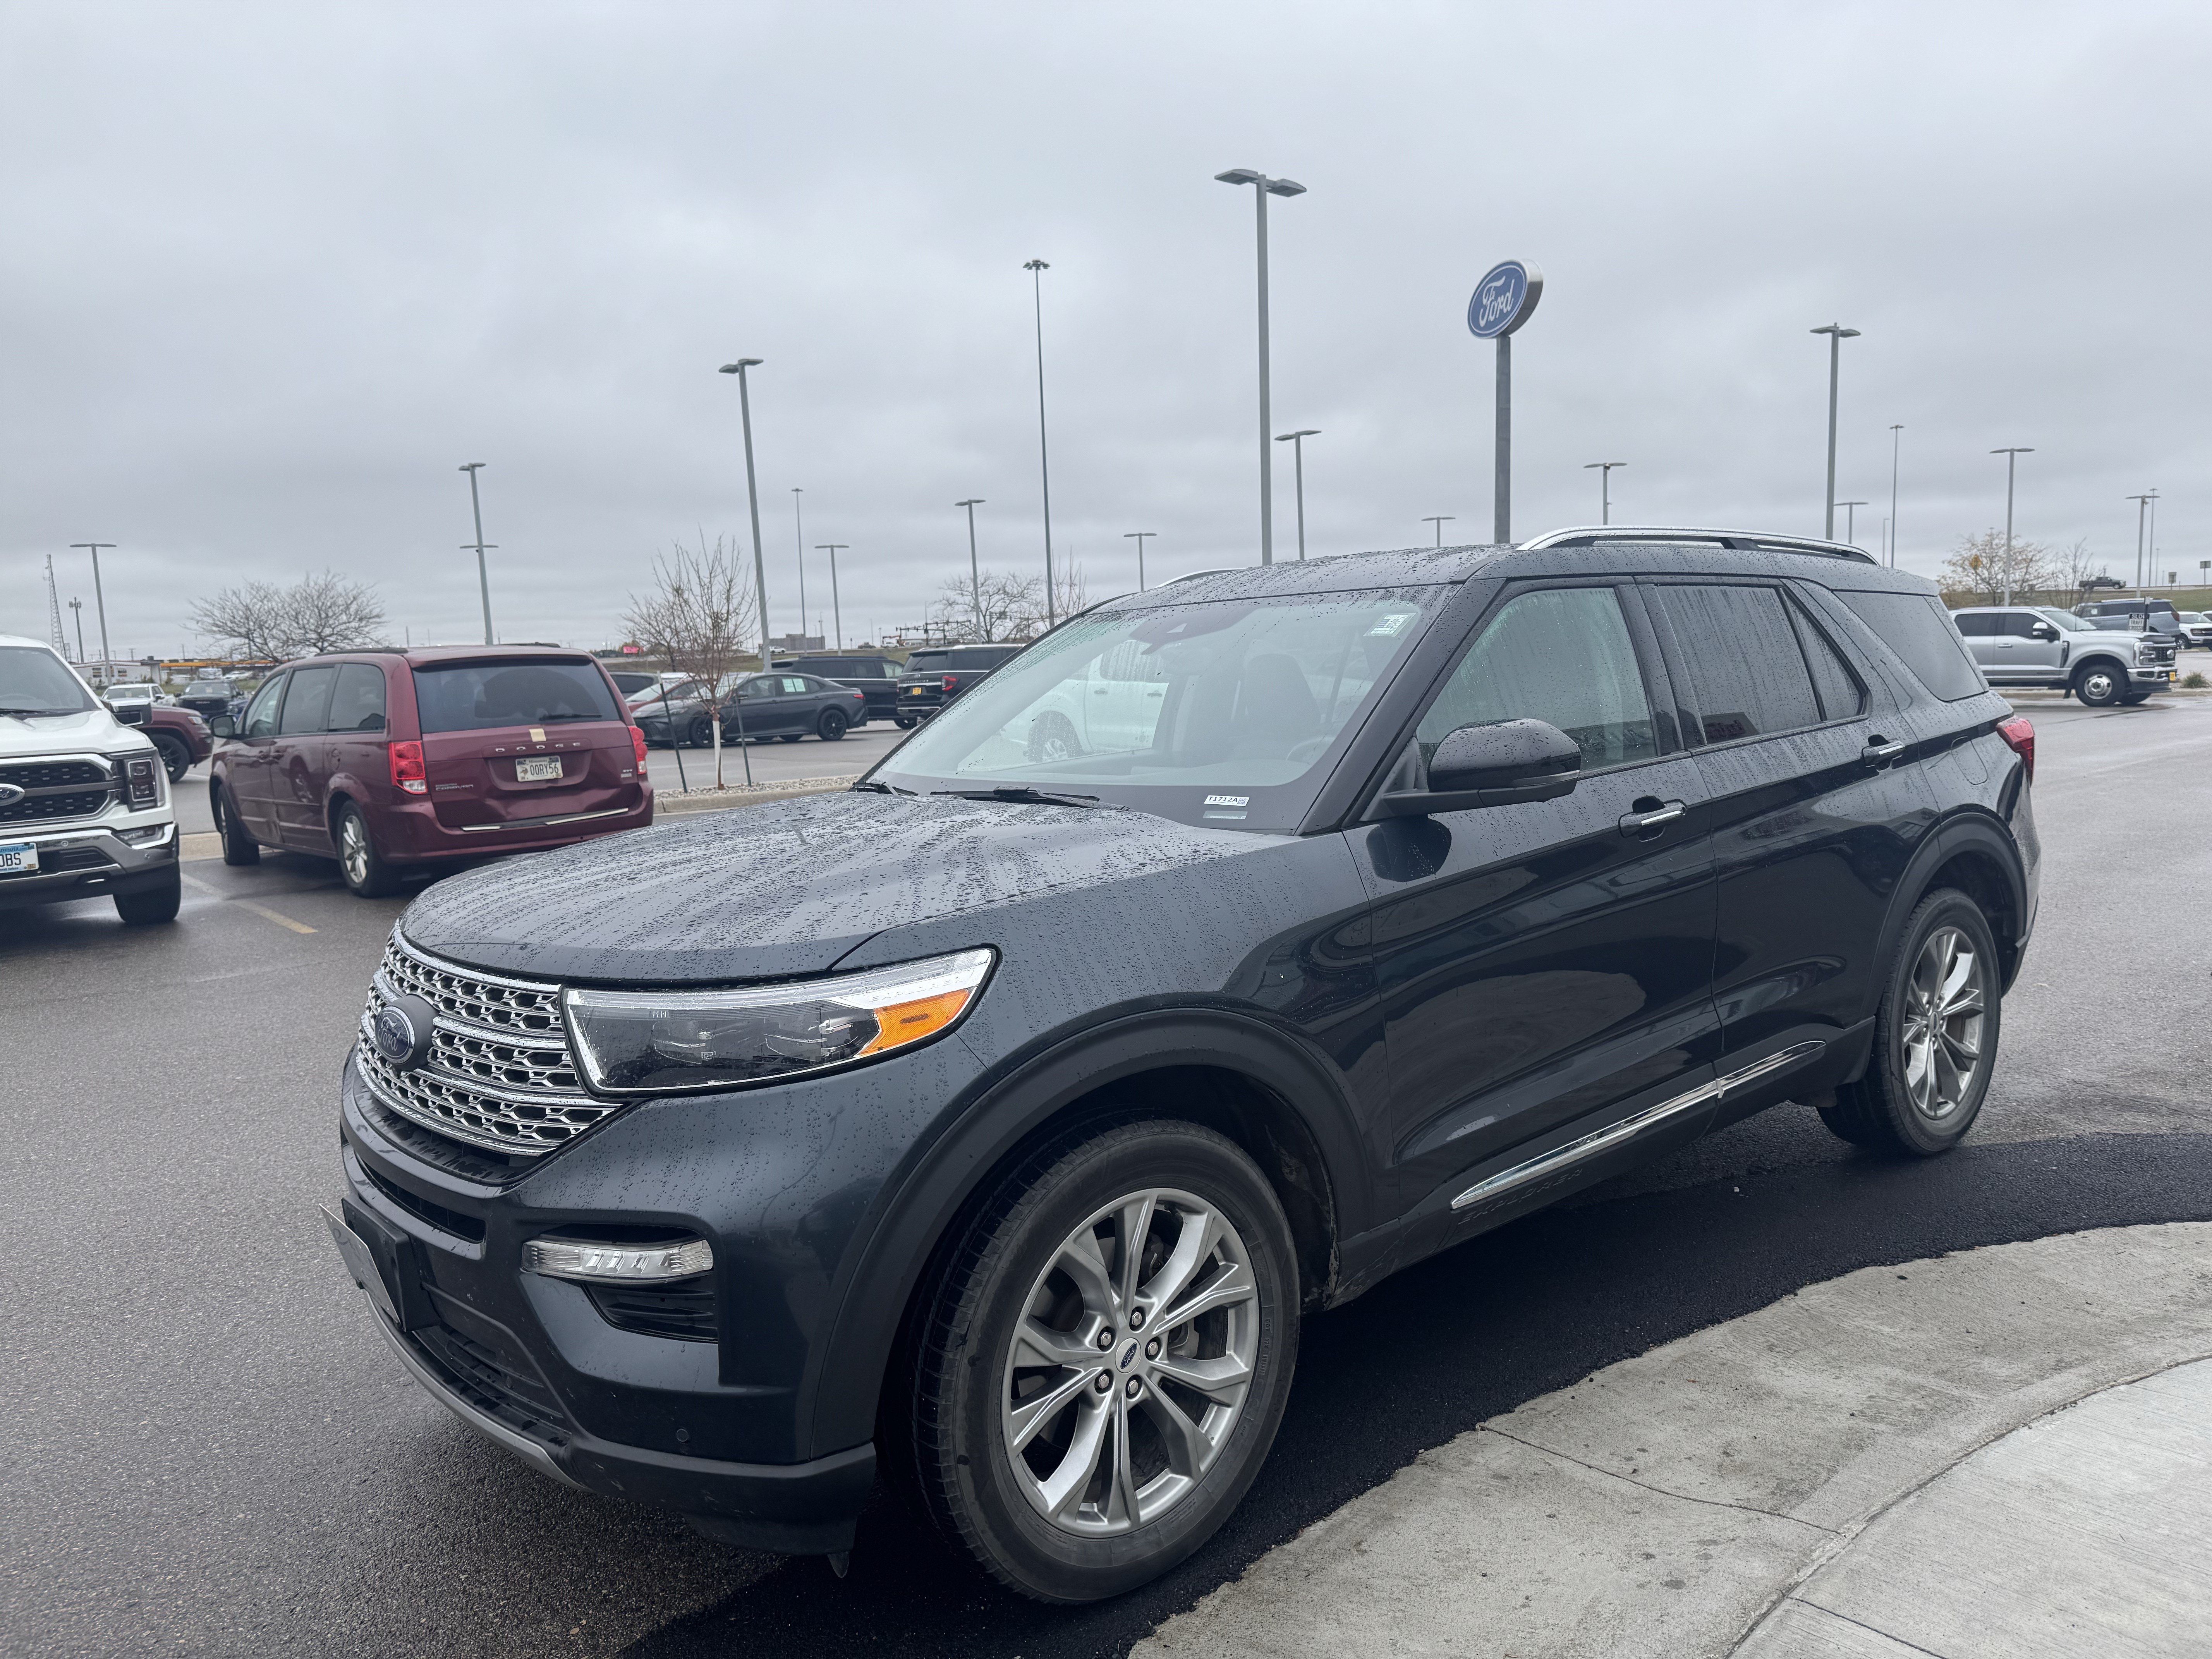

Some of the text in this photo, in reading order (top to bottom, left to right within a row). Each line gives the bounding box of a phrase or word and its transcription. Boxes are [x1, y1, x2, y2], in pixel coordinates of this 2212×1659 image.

[1479, 276, 1515, 327] Ford
[495, 742, 580, 752] DODGE
[378, 1017, 401, 1051] Ford
[1124, 1347, 1135, 1365] Ford
